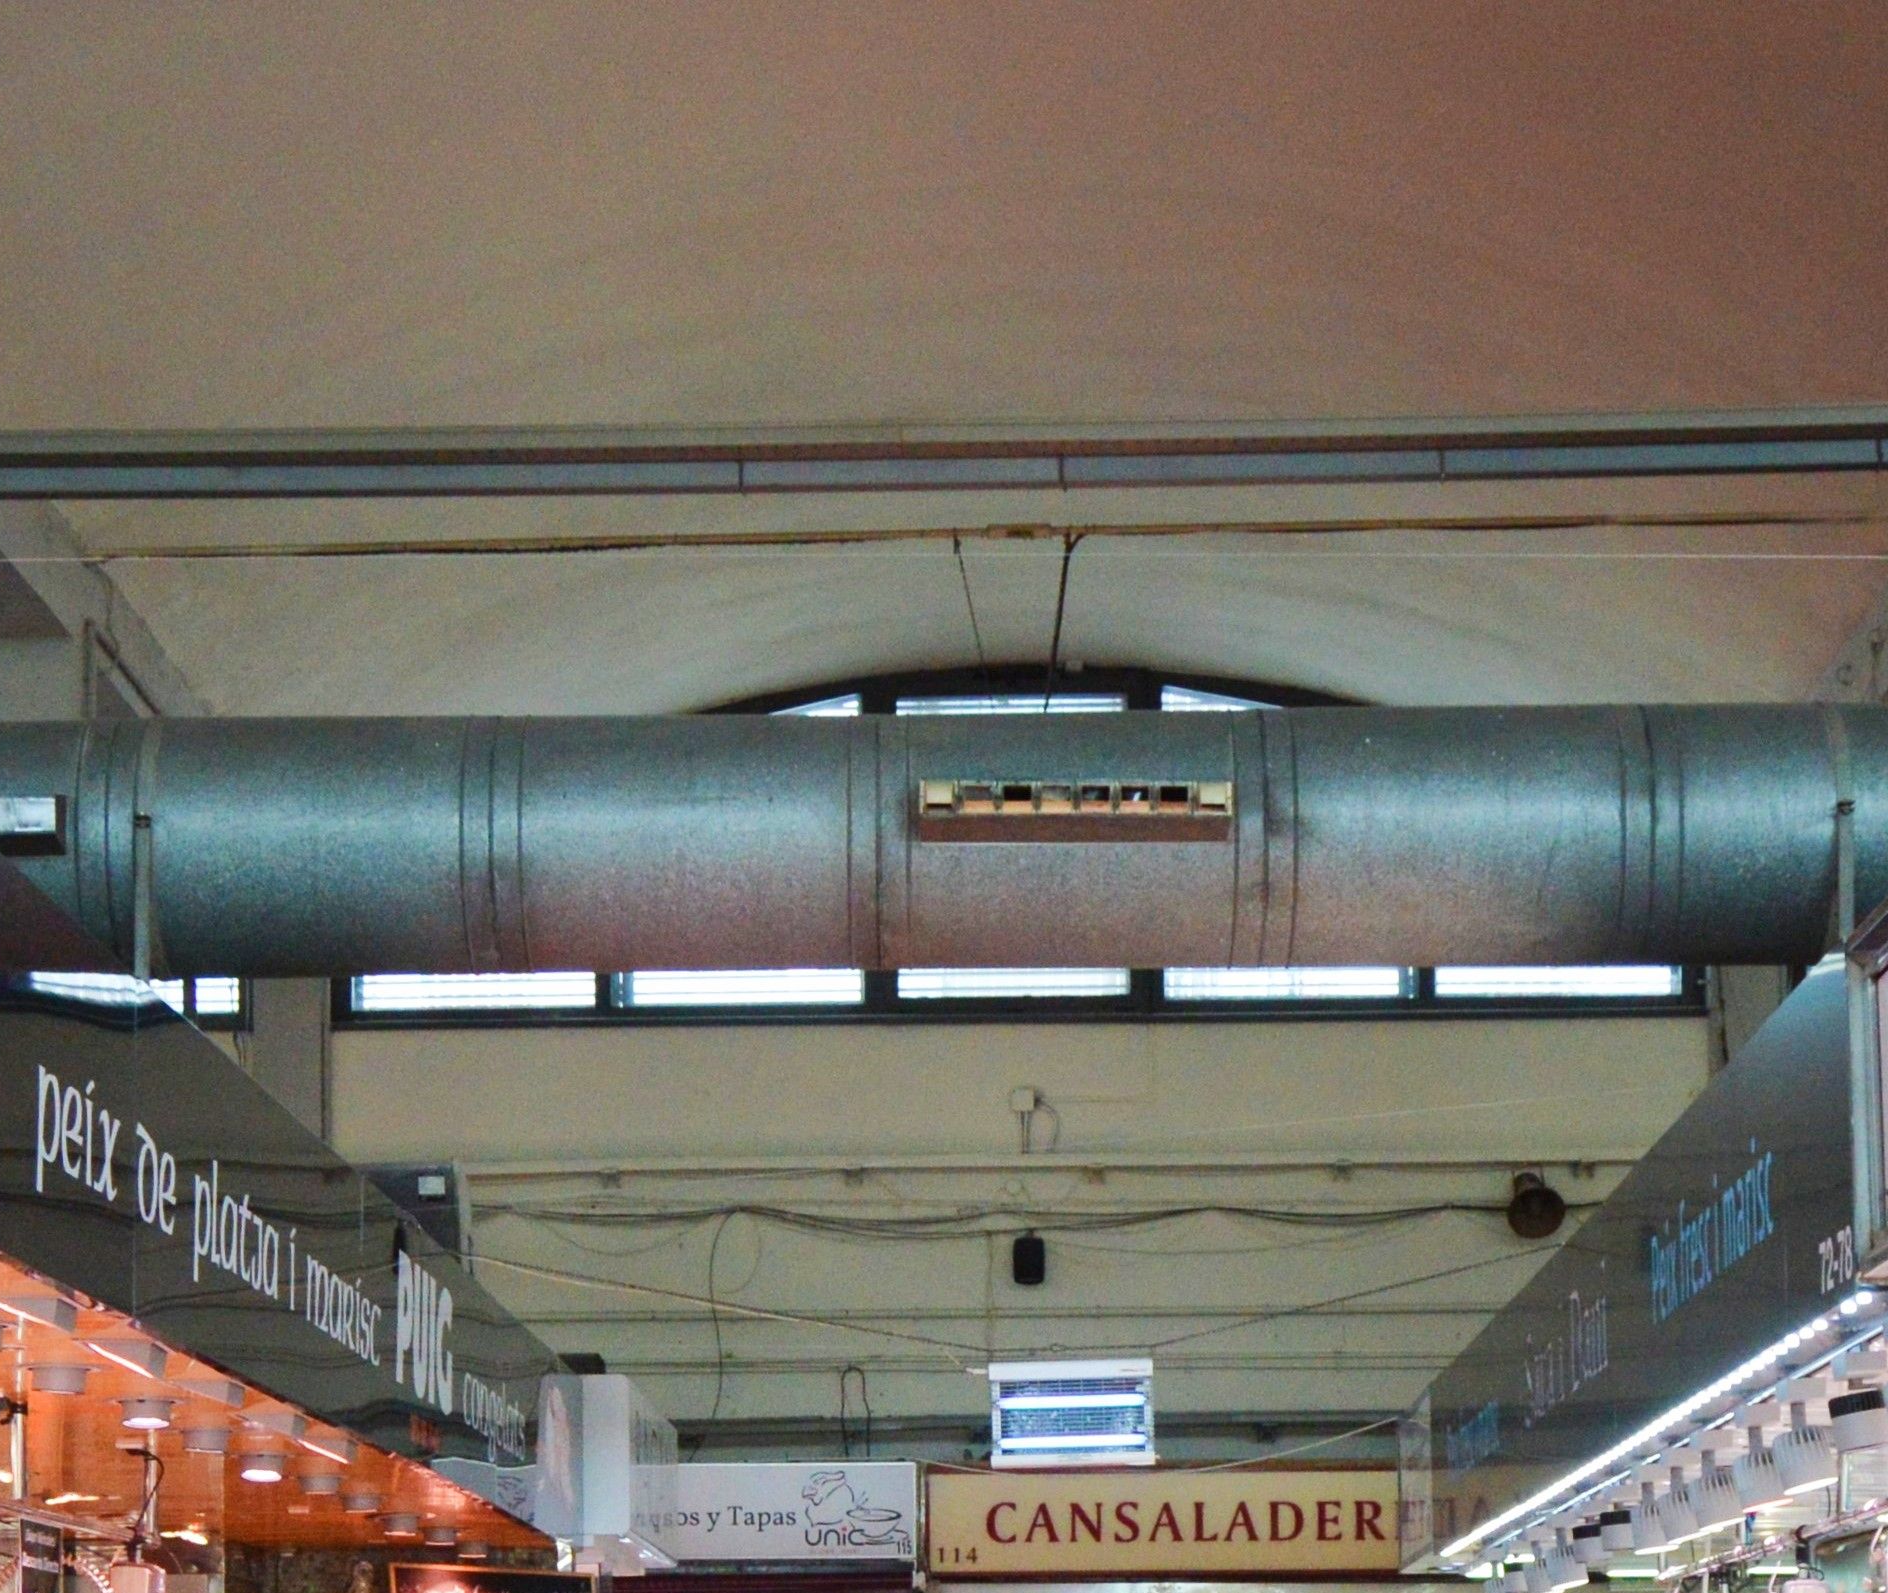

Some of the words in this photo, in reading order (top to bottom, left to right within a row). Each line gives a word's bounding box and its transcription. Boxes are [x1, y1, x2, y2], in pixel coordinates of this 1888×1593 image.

[36, 1064, 121, 1201] peix
[136, 1122, 176, 1235] de
[193, 1160, 279, 1300] platja
[307, 1254, 382, 1366] marisc
[396, 1249, 453, 1416] PUIG
[1818, 1225, 1853, 1294] 72-78
[707, 1511, 721, 1532] y
[727, 1506, 797, 1531] Tapas
[936, 1545, 978, 1564] 114
